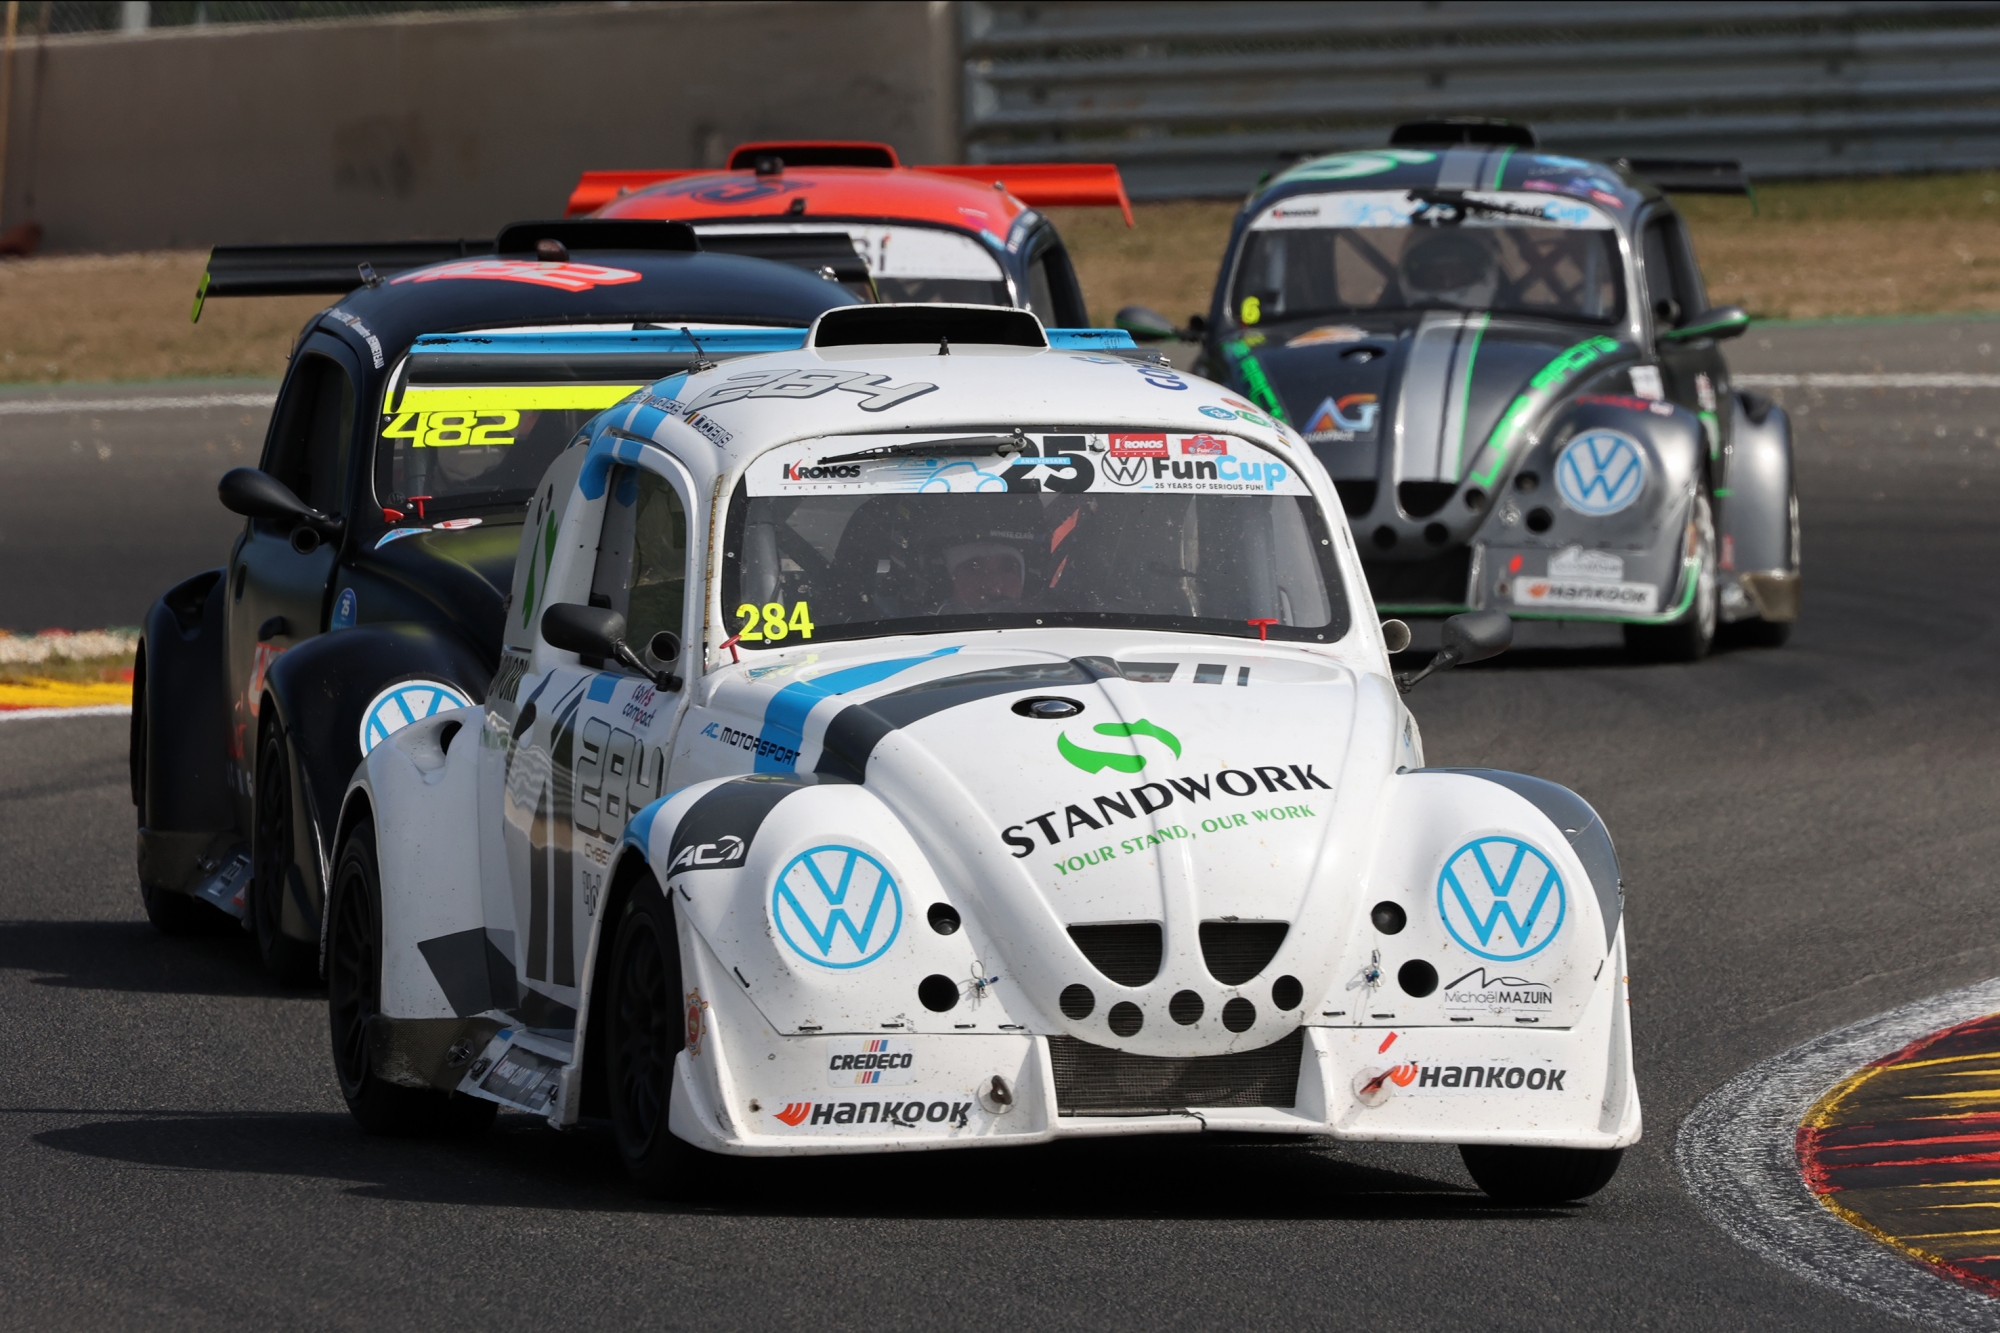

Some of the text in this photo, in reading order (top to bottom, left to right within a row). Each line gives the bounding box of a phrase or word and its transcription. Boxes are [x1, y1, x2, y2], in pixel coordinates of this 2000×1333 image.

[1240, 296, 1260, 325] 6
[684, 368, 939, 413] 284
[382, 410, 520, 448] 482
[1115, 435, 1164, 450] KRONOS
[783, 459, 861, 481] KRONOS
[1152, 455, 1287, 490] FunCup
[736, 601, 814, 642] 284
[700, 722, 801, 766] AC MOTORSPORT
[574, 716, 665, 845] 284
[1001, 764, 1333, 858] STANDWORK
[1054, 804, 1316, 875] YOUR STAND, OUR WORK
[829, 1053, 913, 1071] CREDECO
